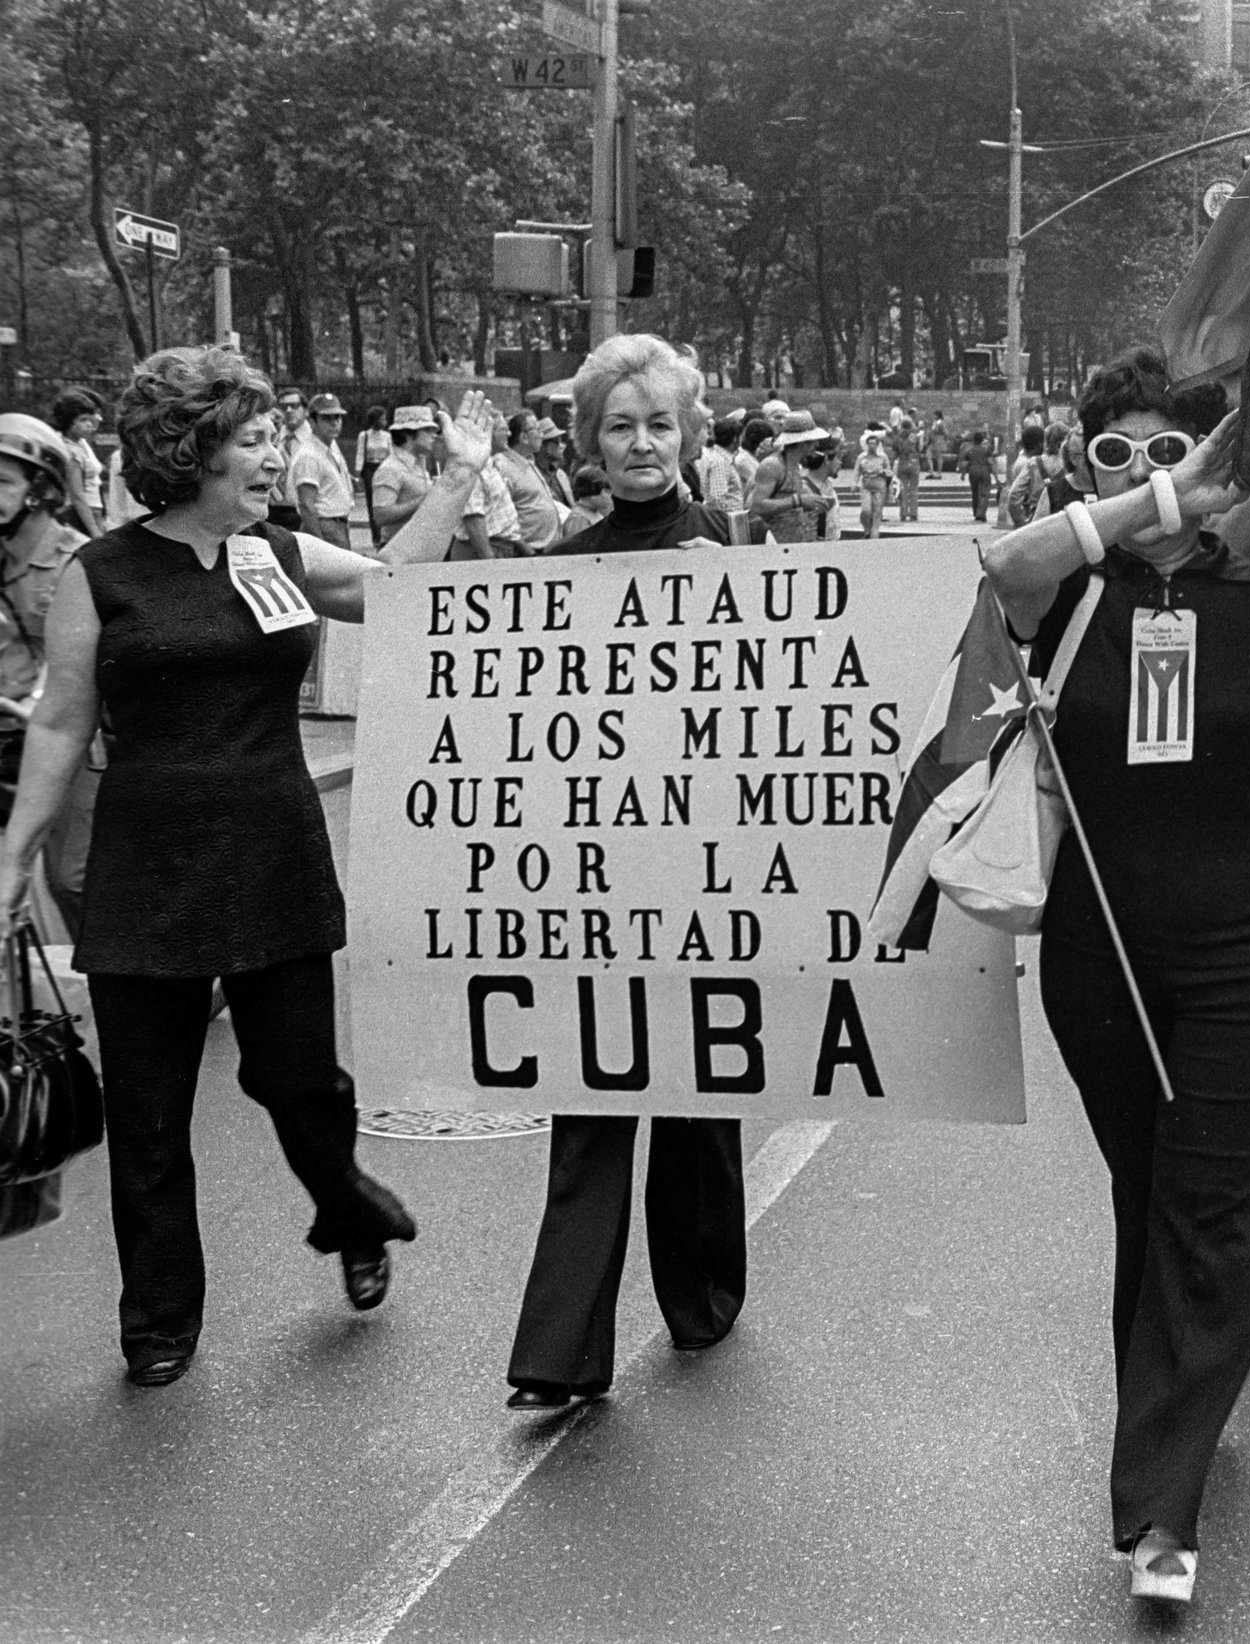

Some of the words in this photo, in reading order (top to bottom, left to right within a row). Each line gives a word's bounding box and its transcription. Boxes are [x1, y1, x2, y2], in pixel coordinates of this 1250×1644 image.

[511, 58, 529, 82] W
[535, 58, 567, 84] 42
[125, 222, 144, 240] ONE
[155, 233, 174, 246] WAY
[428, 580, 572, 635] ESTE
[615, 567, 847, 627] ATAUD
[428, 635, 869, 698] REPRESENTA
[429, 715, 461, 763] A
[507, 710, 627, 762] LOS
[681, 703, 901, 759] MILES
[406, 780, 523, 829] QUE
[564, 775, 693, 827] HAN
[736, 772, 906, 826] MUER
[467, 842, 611, 894] POR
[703, 842, 799, 894] LA
[425, 908, 762, 961] LIBERTAD
[468, 975, 884, 1097] CUBA
